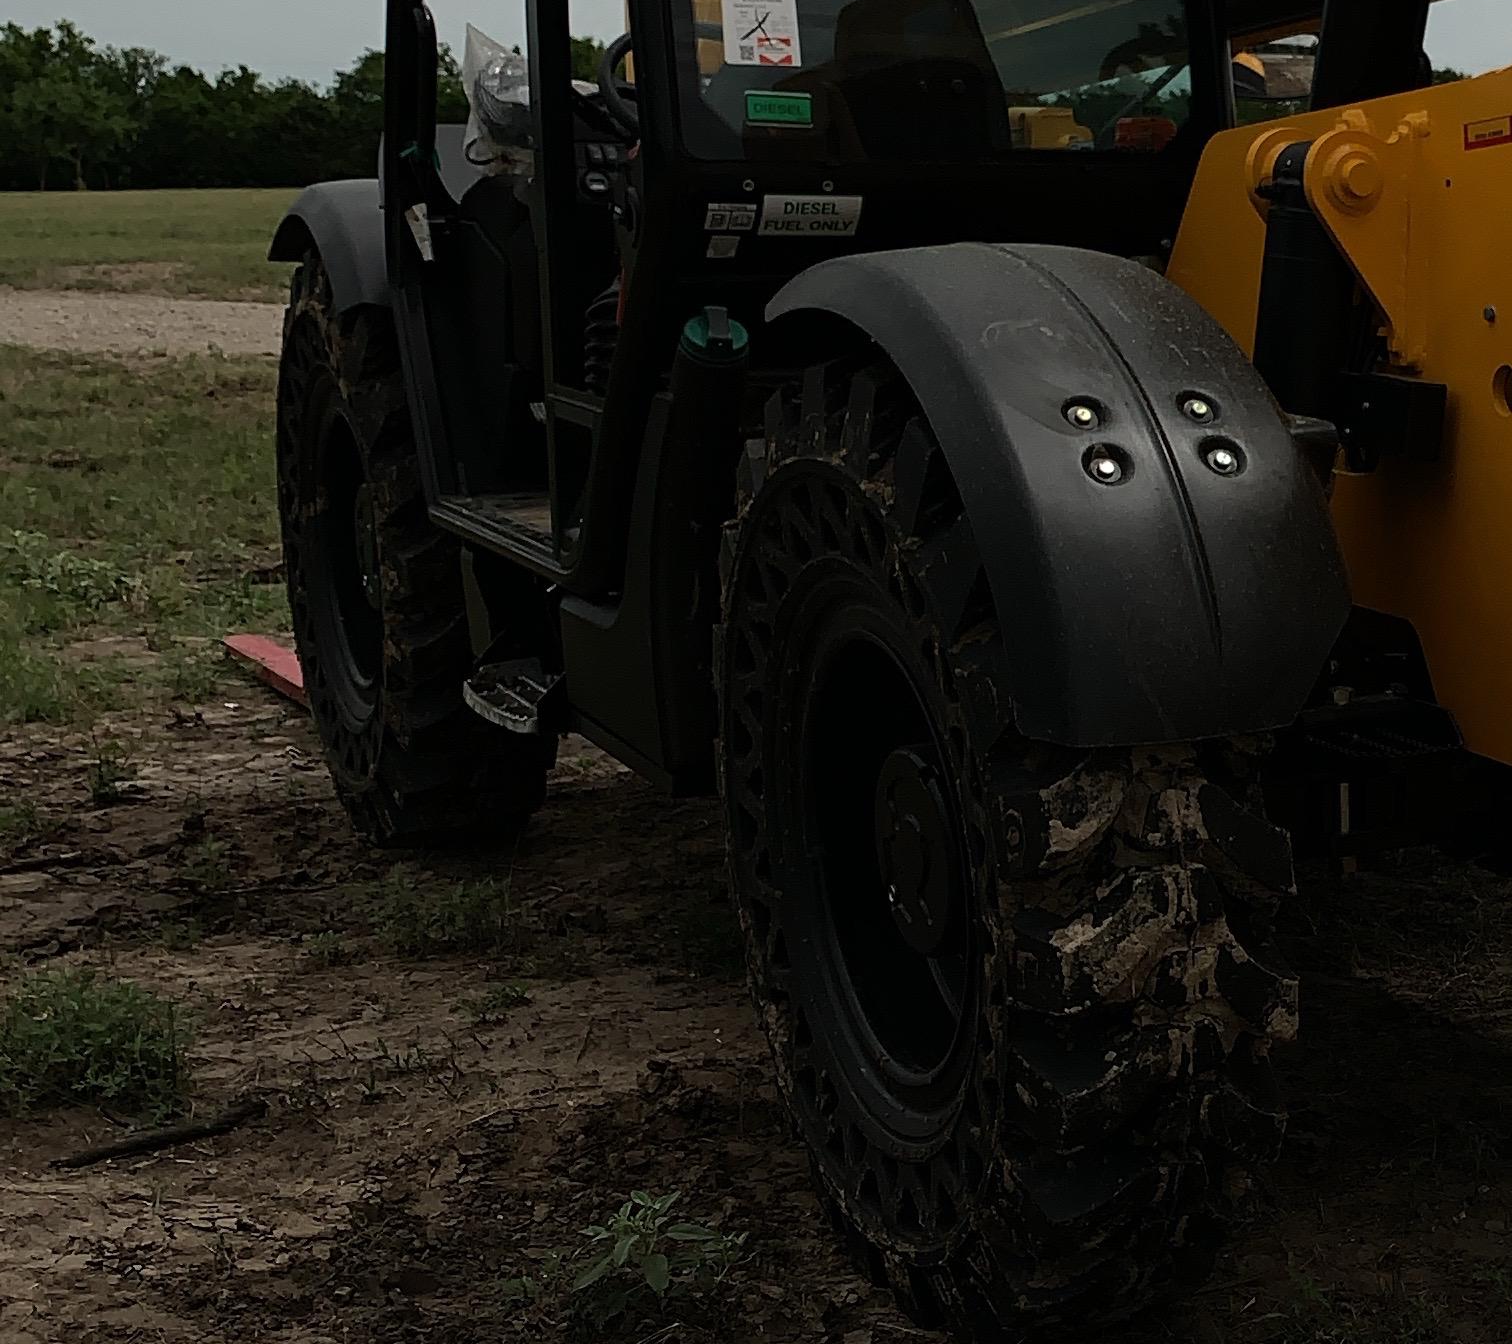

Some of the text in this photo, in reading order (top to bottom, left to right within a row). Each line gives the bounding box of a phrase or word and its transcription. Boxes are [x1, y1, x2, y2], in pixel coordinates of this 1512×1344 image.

[783, 201, 841, 216] DIESEL
[763, 220, 854, 232] FUEL ONLY
